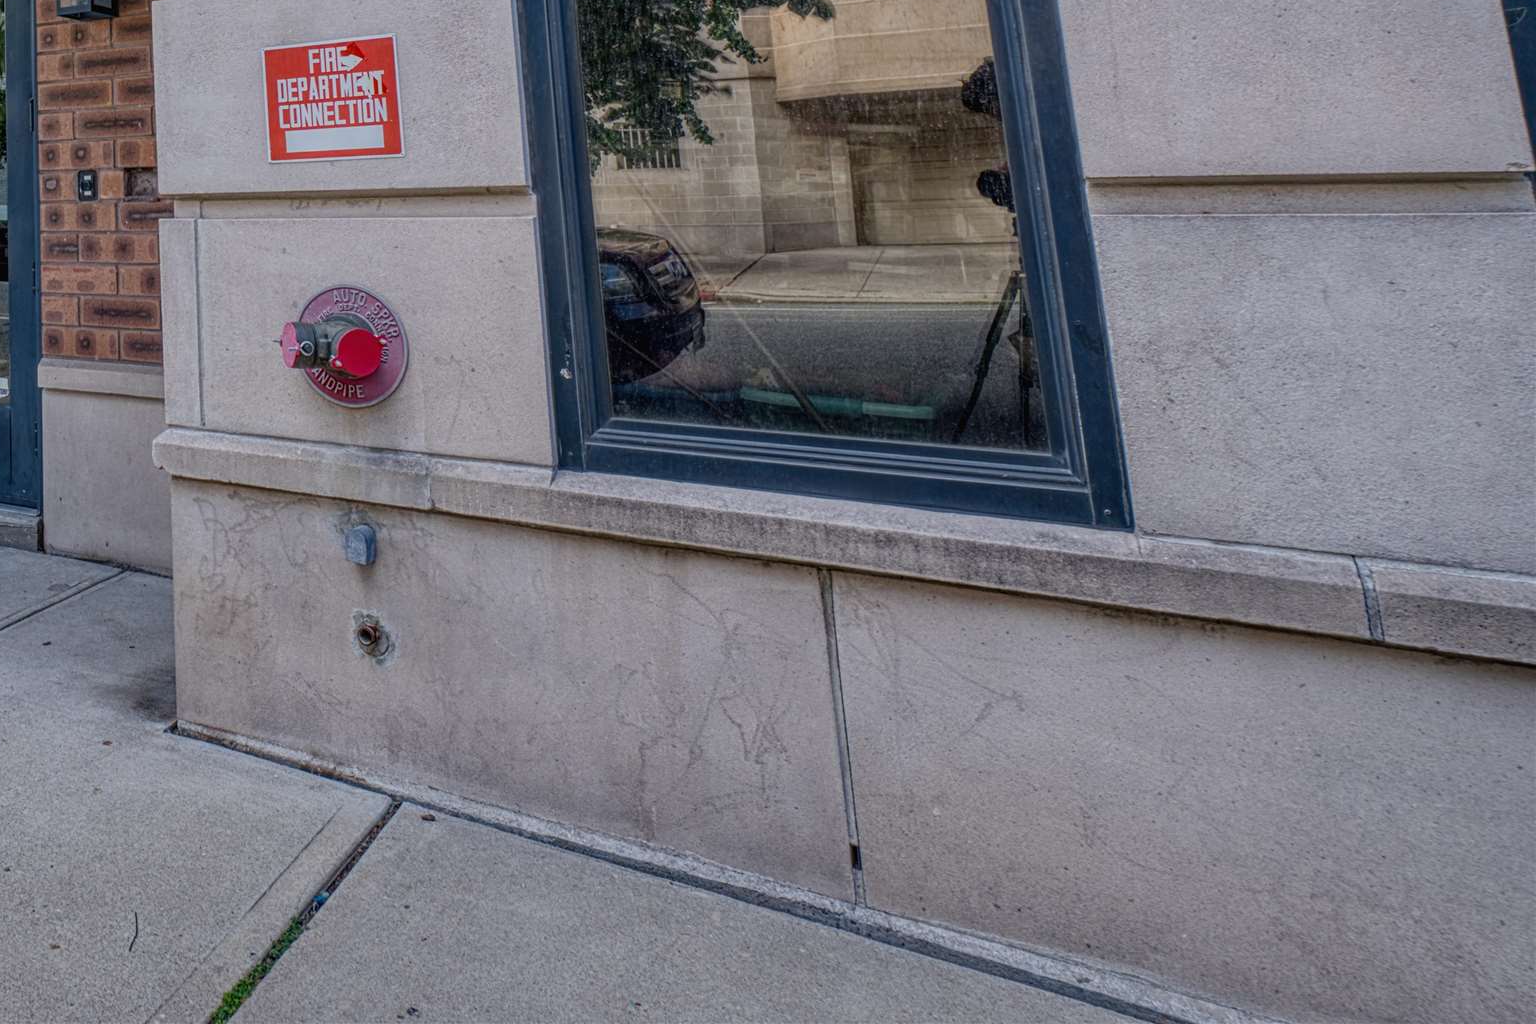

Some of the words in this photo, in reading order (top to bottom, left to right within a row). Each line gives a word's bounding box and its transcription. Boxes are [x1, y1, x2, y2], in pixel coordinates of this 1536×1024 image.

[308, 46, 349, 74] FIRE
[277, 70, 385, 102] DEPARTMENT
[278, 97, 388, 129] CONNECTION
[312, 367, 365, 398] ANDPIPE
